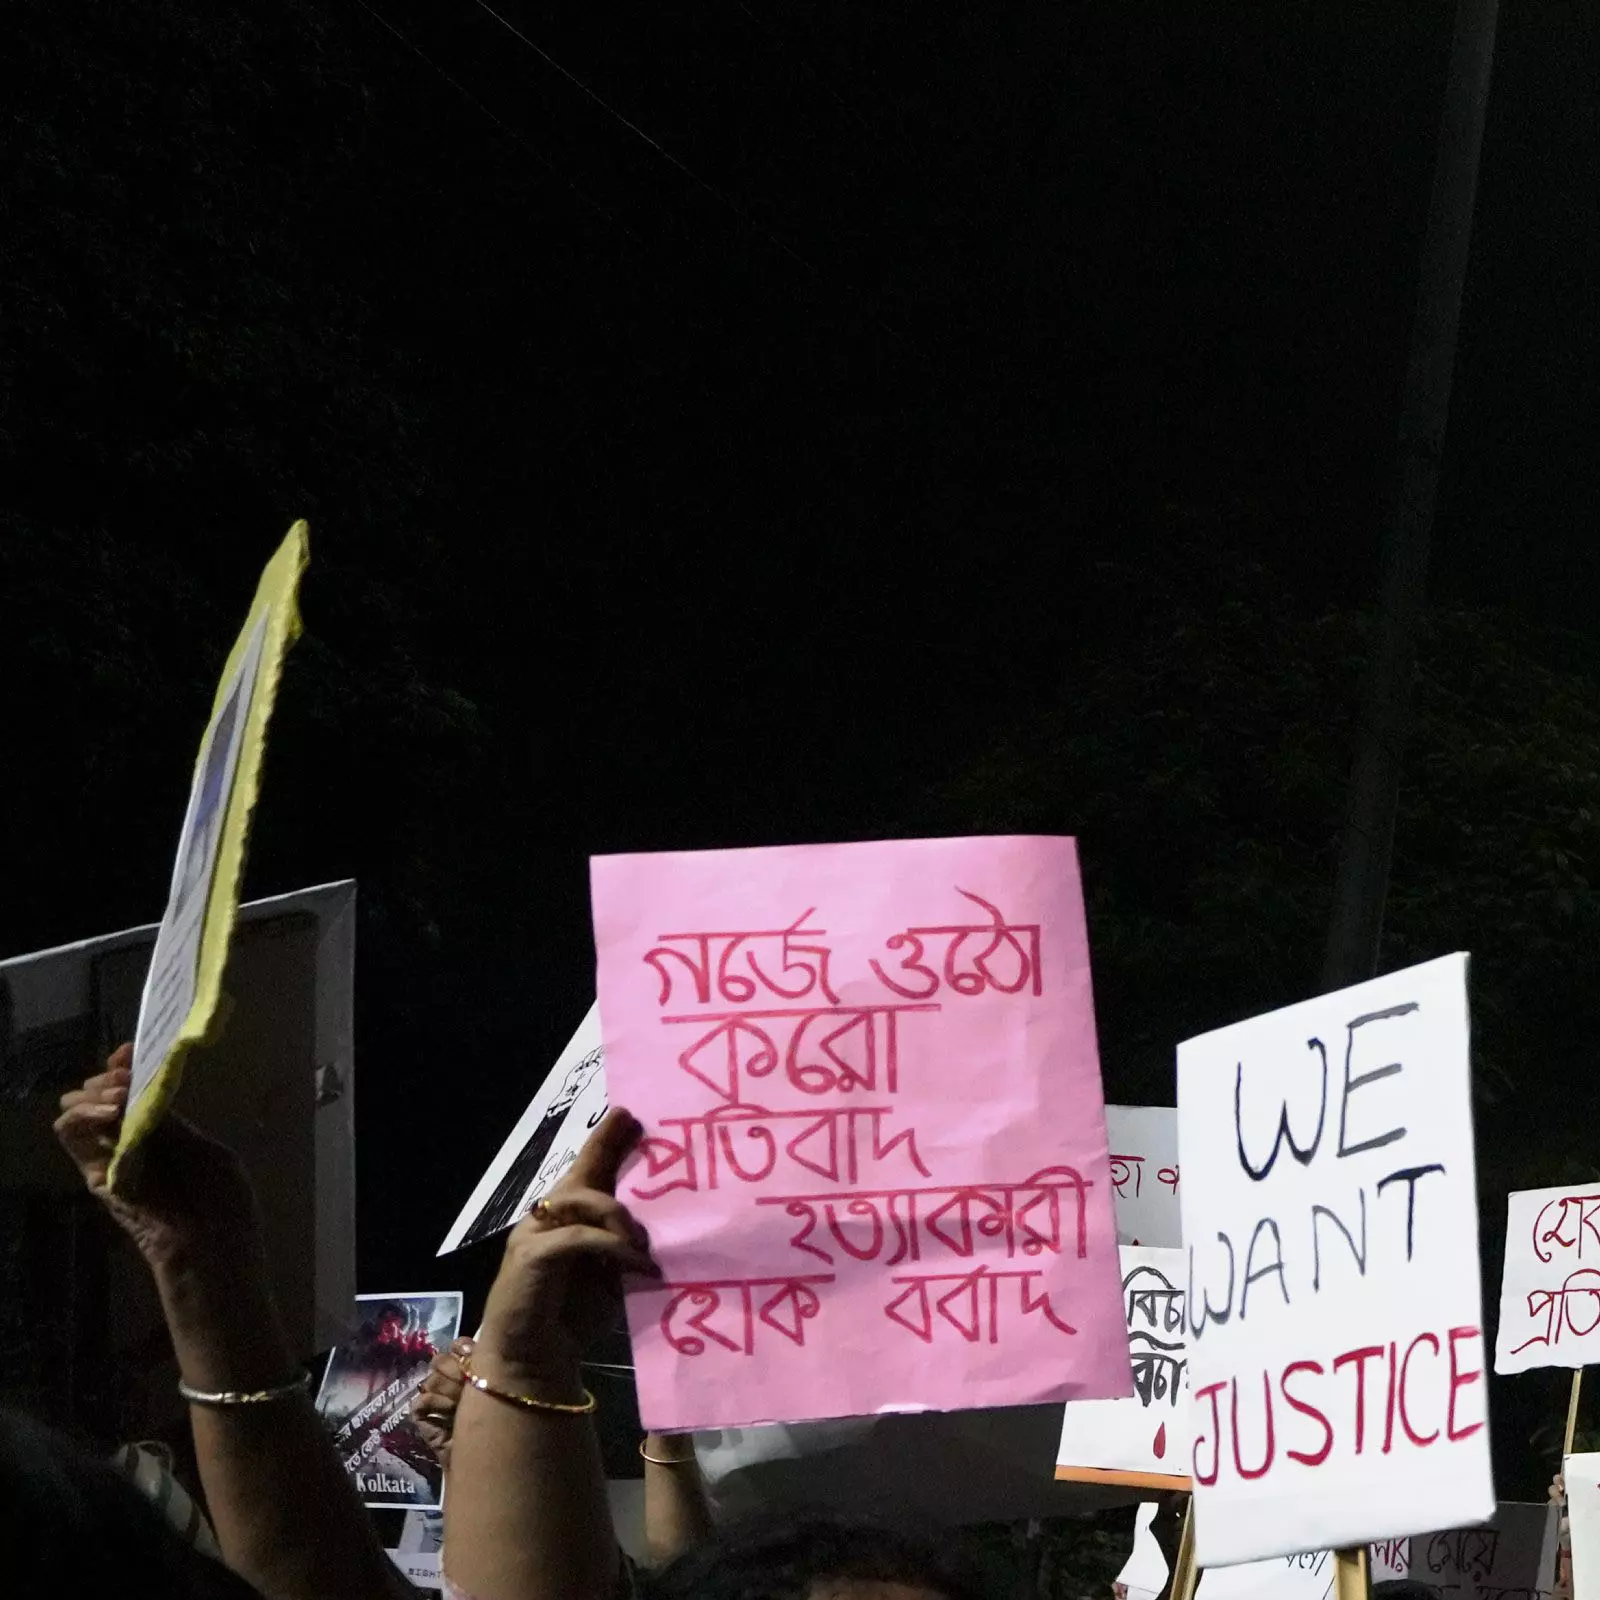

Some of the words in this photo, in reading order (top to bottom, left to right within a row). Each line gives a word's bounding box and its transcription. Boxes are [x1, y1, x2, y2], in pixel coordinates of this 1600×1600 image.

[662, 1004, 941, 1105] করো
[1236, 1002, 1420, 1181] WE
[1188, 1164, 1447, 1338] WANT
[356, 1472, 416, 1493] Kolkata
[1193, 1326, 1485, 1486] JUSTICE
